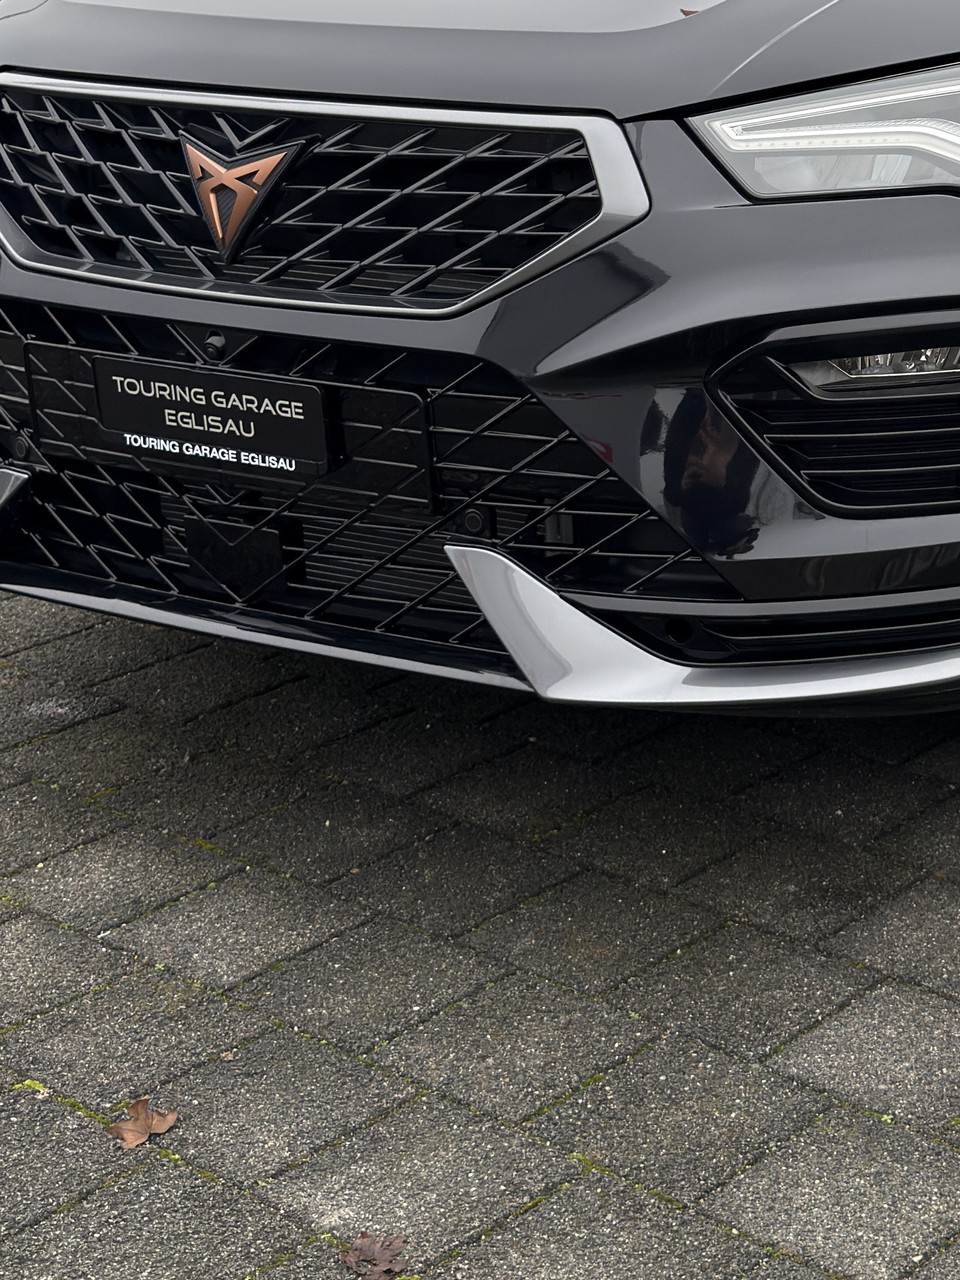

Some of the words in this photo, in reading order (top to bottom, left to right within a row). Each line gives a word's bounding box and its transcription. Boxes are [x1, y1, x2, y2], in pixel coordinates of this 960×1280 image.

[112, 376, 206, 405] TOURING
[211, 391, 304, 419] GARAGE
[164, 408, 255, 437] EGLISAU
[124, 433, 180, 453] TOURING
[182, 443, 237, 462] GARAGE
[240, 452, 295, 471] EGLISAU
